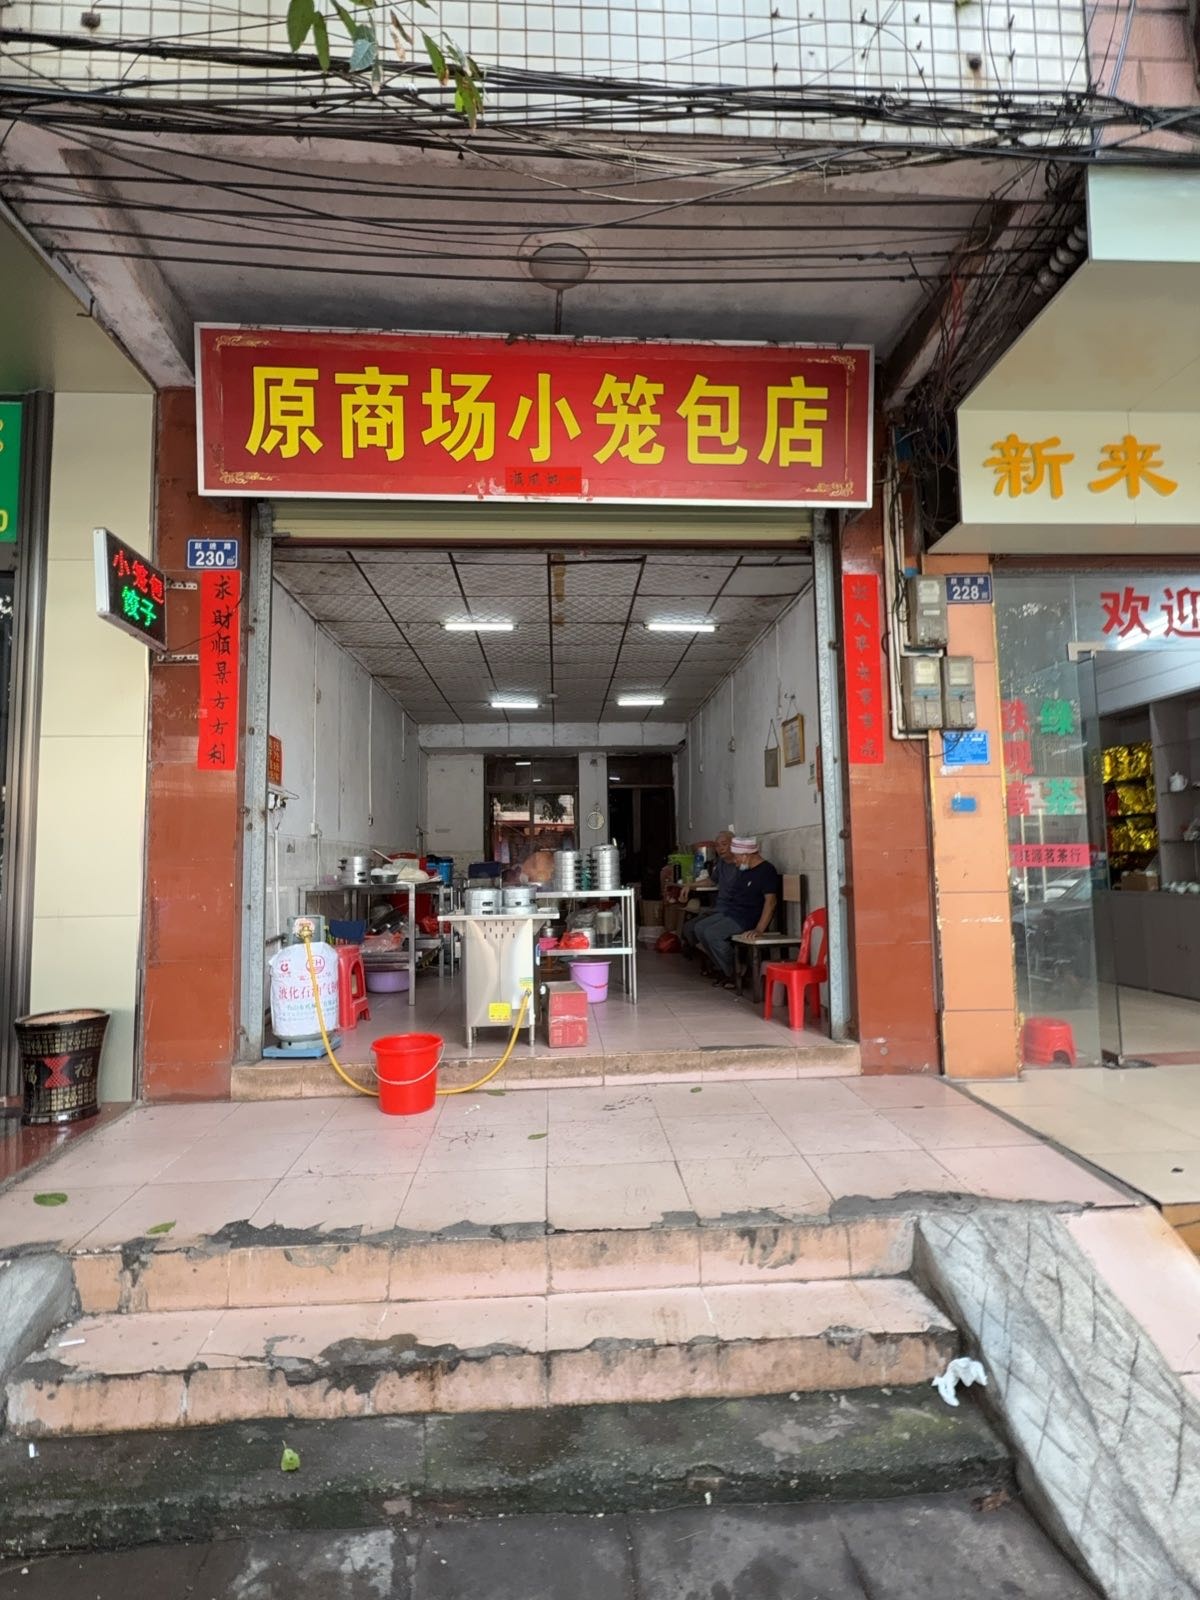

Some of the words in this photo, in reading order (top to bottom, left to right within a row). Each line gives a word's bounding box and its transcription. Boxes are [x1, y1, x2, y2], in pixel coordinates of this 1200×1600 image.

[245, 366, 829, 468] 原商场小笼包店
[982, 432, 1179, 499] 新来
[195, 551, 225, 566] 230
[952, 586, 980, 600] 228
